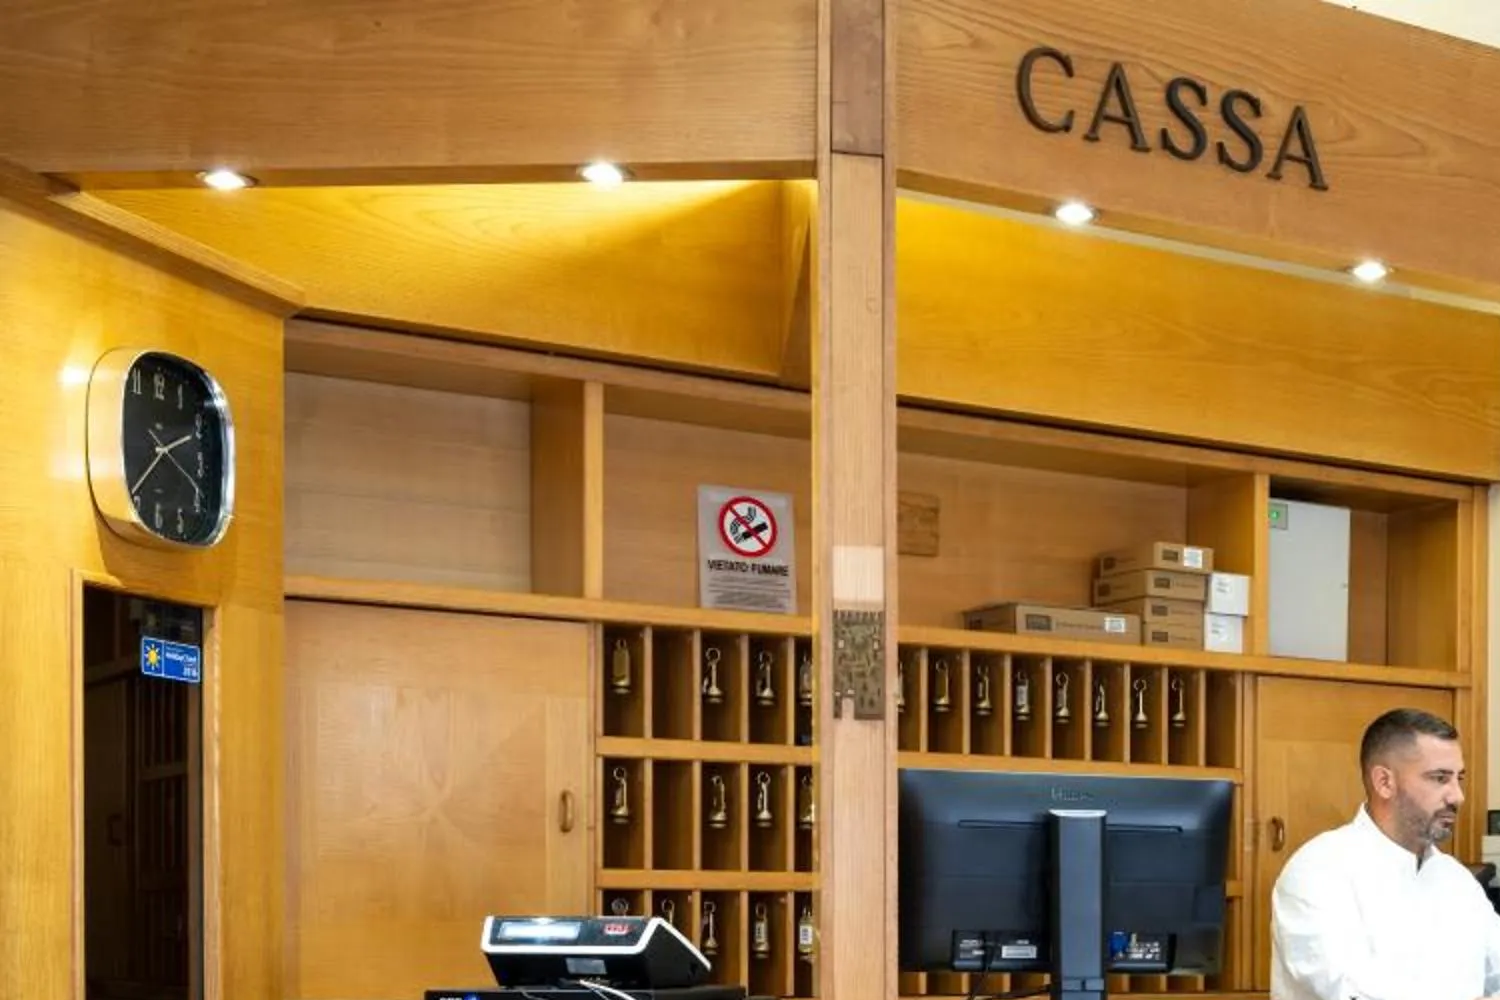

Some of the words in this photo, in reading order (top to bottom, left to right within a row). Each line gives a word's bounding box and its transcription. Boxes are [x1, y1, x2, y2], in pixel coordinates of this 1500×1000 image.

[1016, 46, 1328, 191] CASSA
[132, 366, 142, 395] 11
[153, 370, 165, 401] 12
[177, 383, 184, 411] 1
[155, 502, 163, 529] 6
[707, 559, 748, 573] VIETATO
[751, 563, 788, 576] FUMARE
